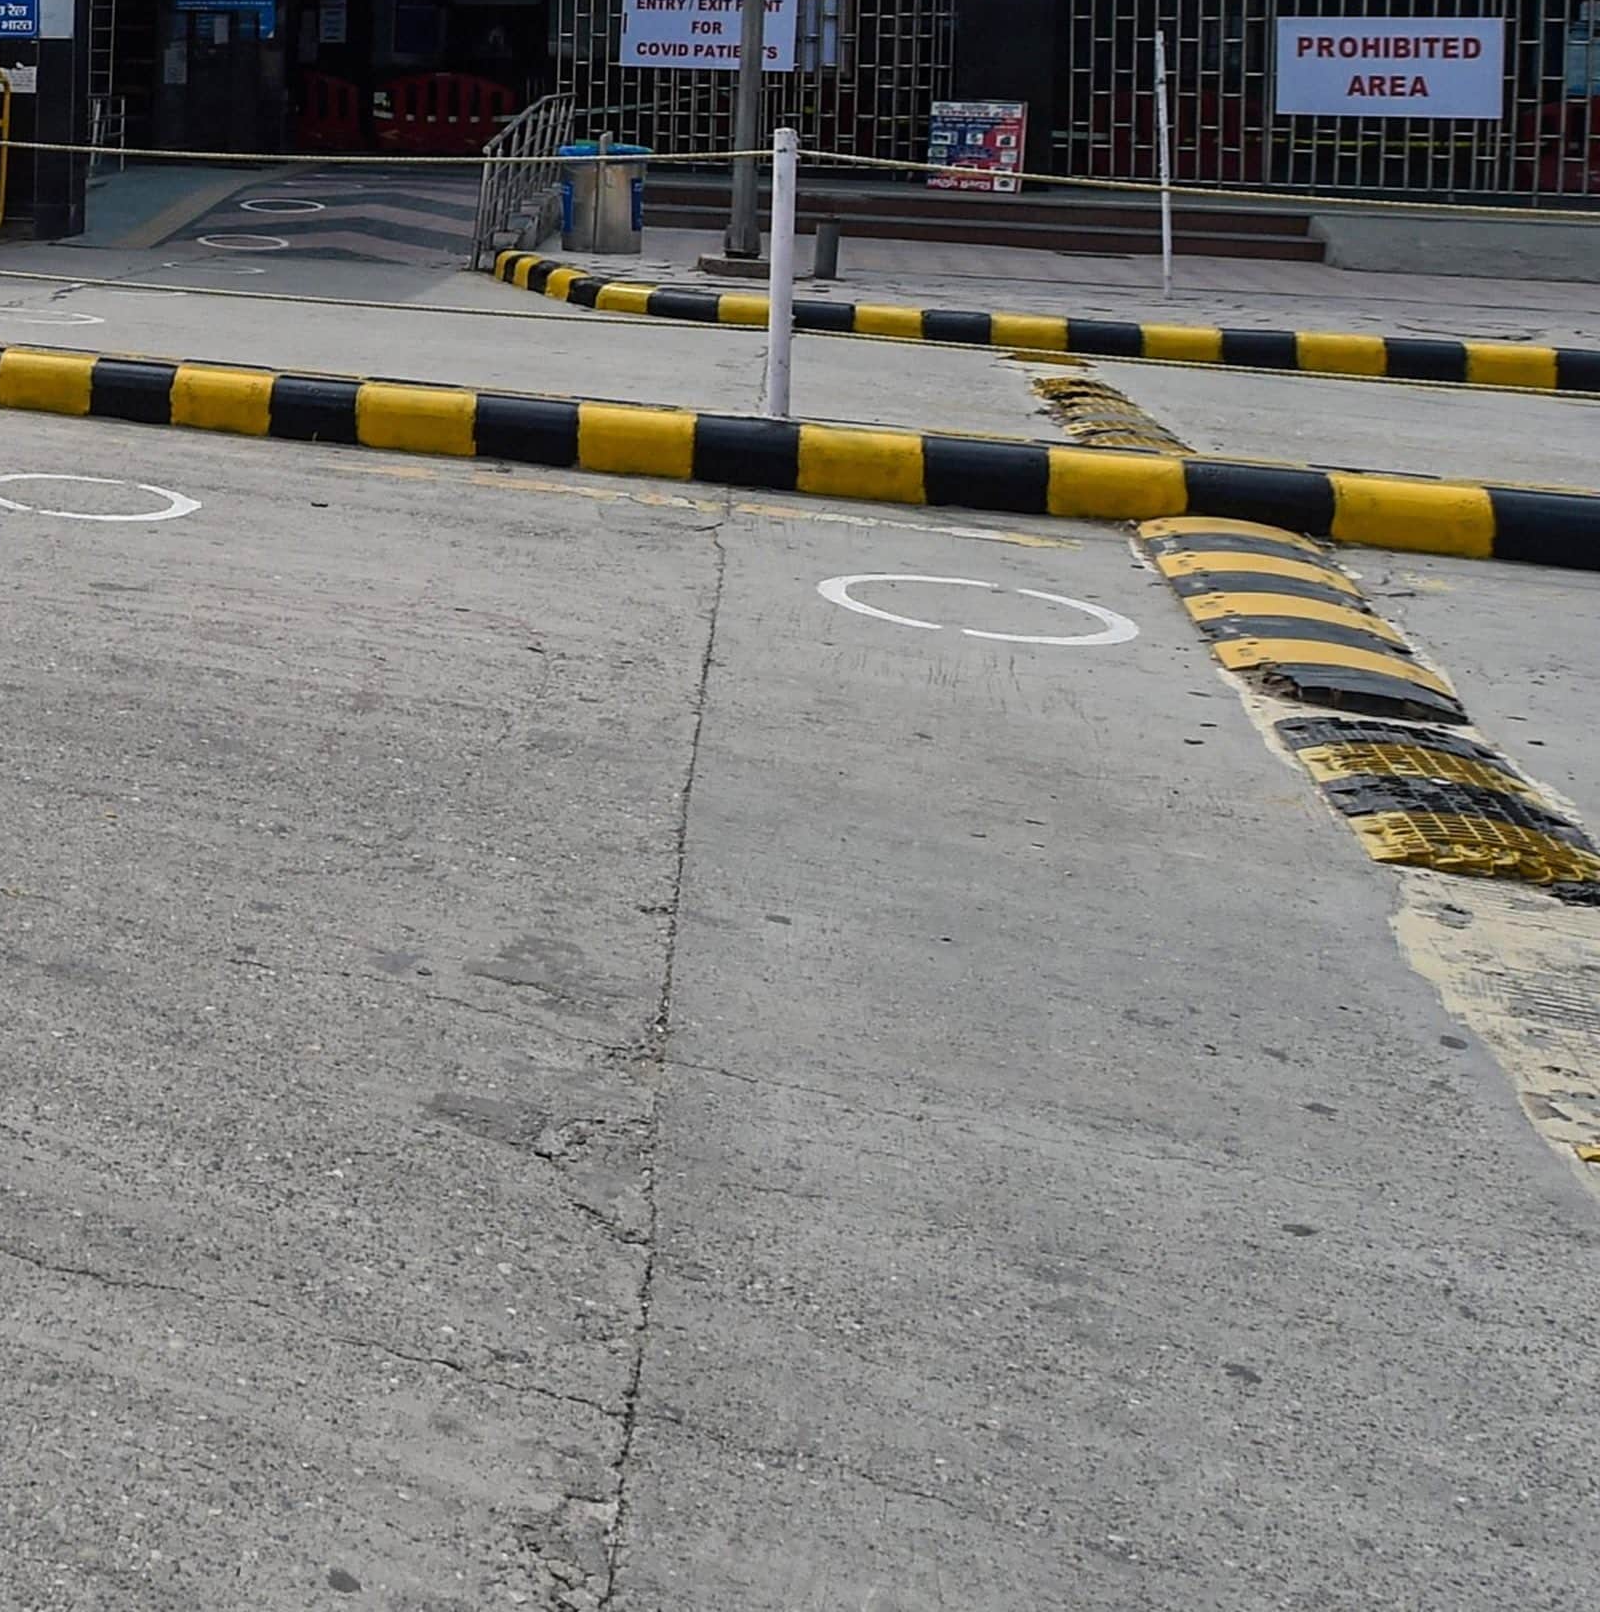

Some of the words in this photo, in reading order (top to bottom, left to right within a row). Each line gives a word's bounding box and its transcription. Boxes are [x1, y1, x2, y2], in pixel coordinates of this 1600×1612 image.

[735, 0, 783, 13] PNT
[691, 21, 722, 34] FOR
[636, 42, 689, 57] COVID
[1296, 37, 1481, 59] PROHIBITED
[1347, 76, 1429, 97] AREA
